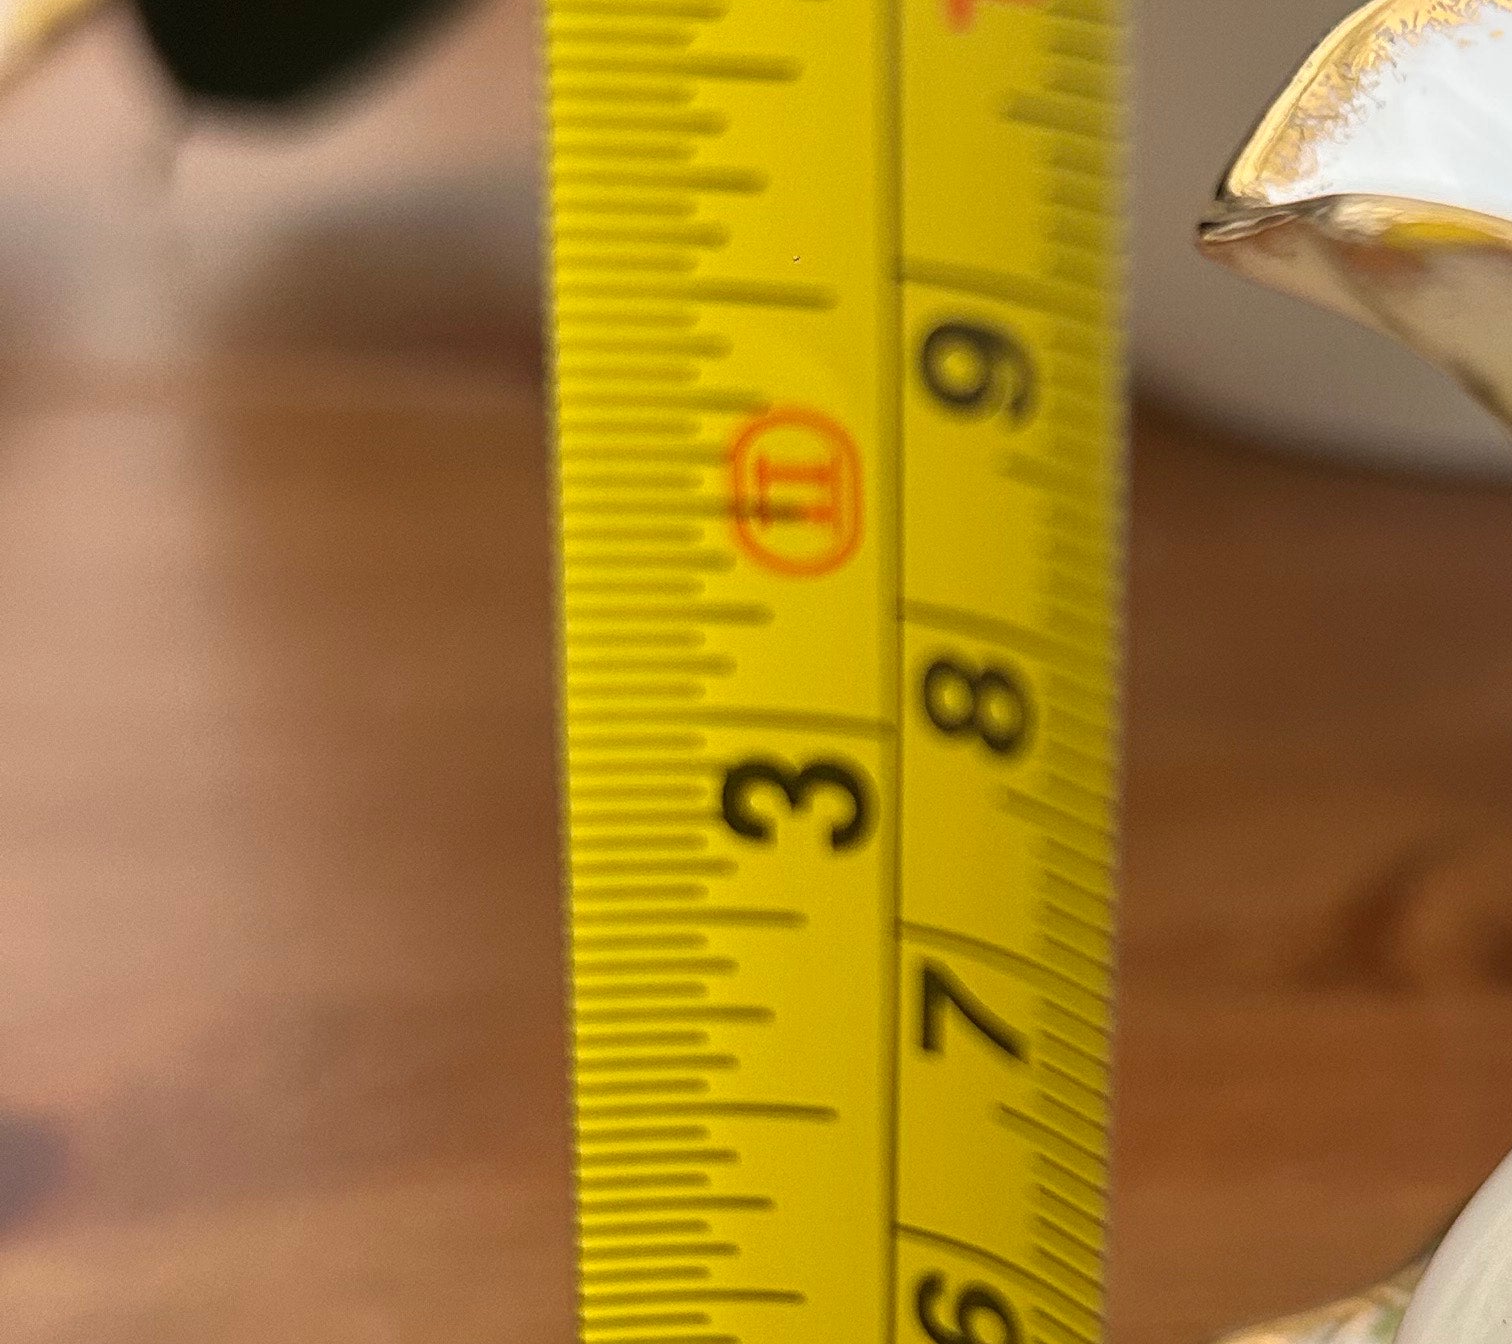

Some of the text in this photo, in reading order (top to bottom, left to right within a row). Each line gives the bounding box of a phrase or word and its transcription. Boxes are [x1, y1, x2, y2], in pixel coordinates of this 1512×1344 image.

[919, 317, 1037, 429] 9
[920, 657, 1032, 758] 8
[721, 754, 876, 855] 3
[919, 960, 1030, 1064] 7
